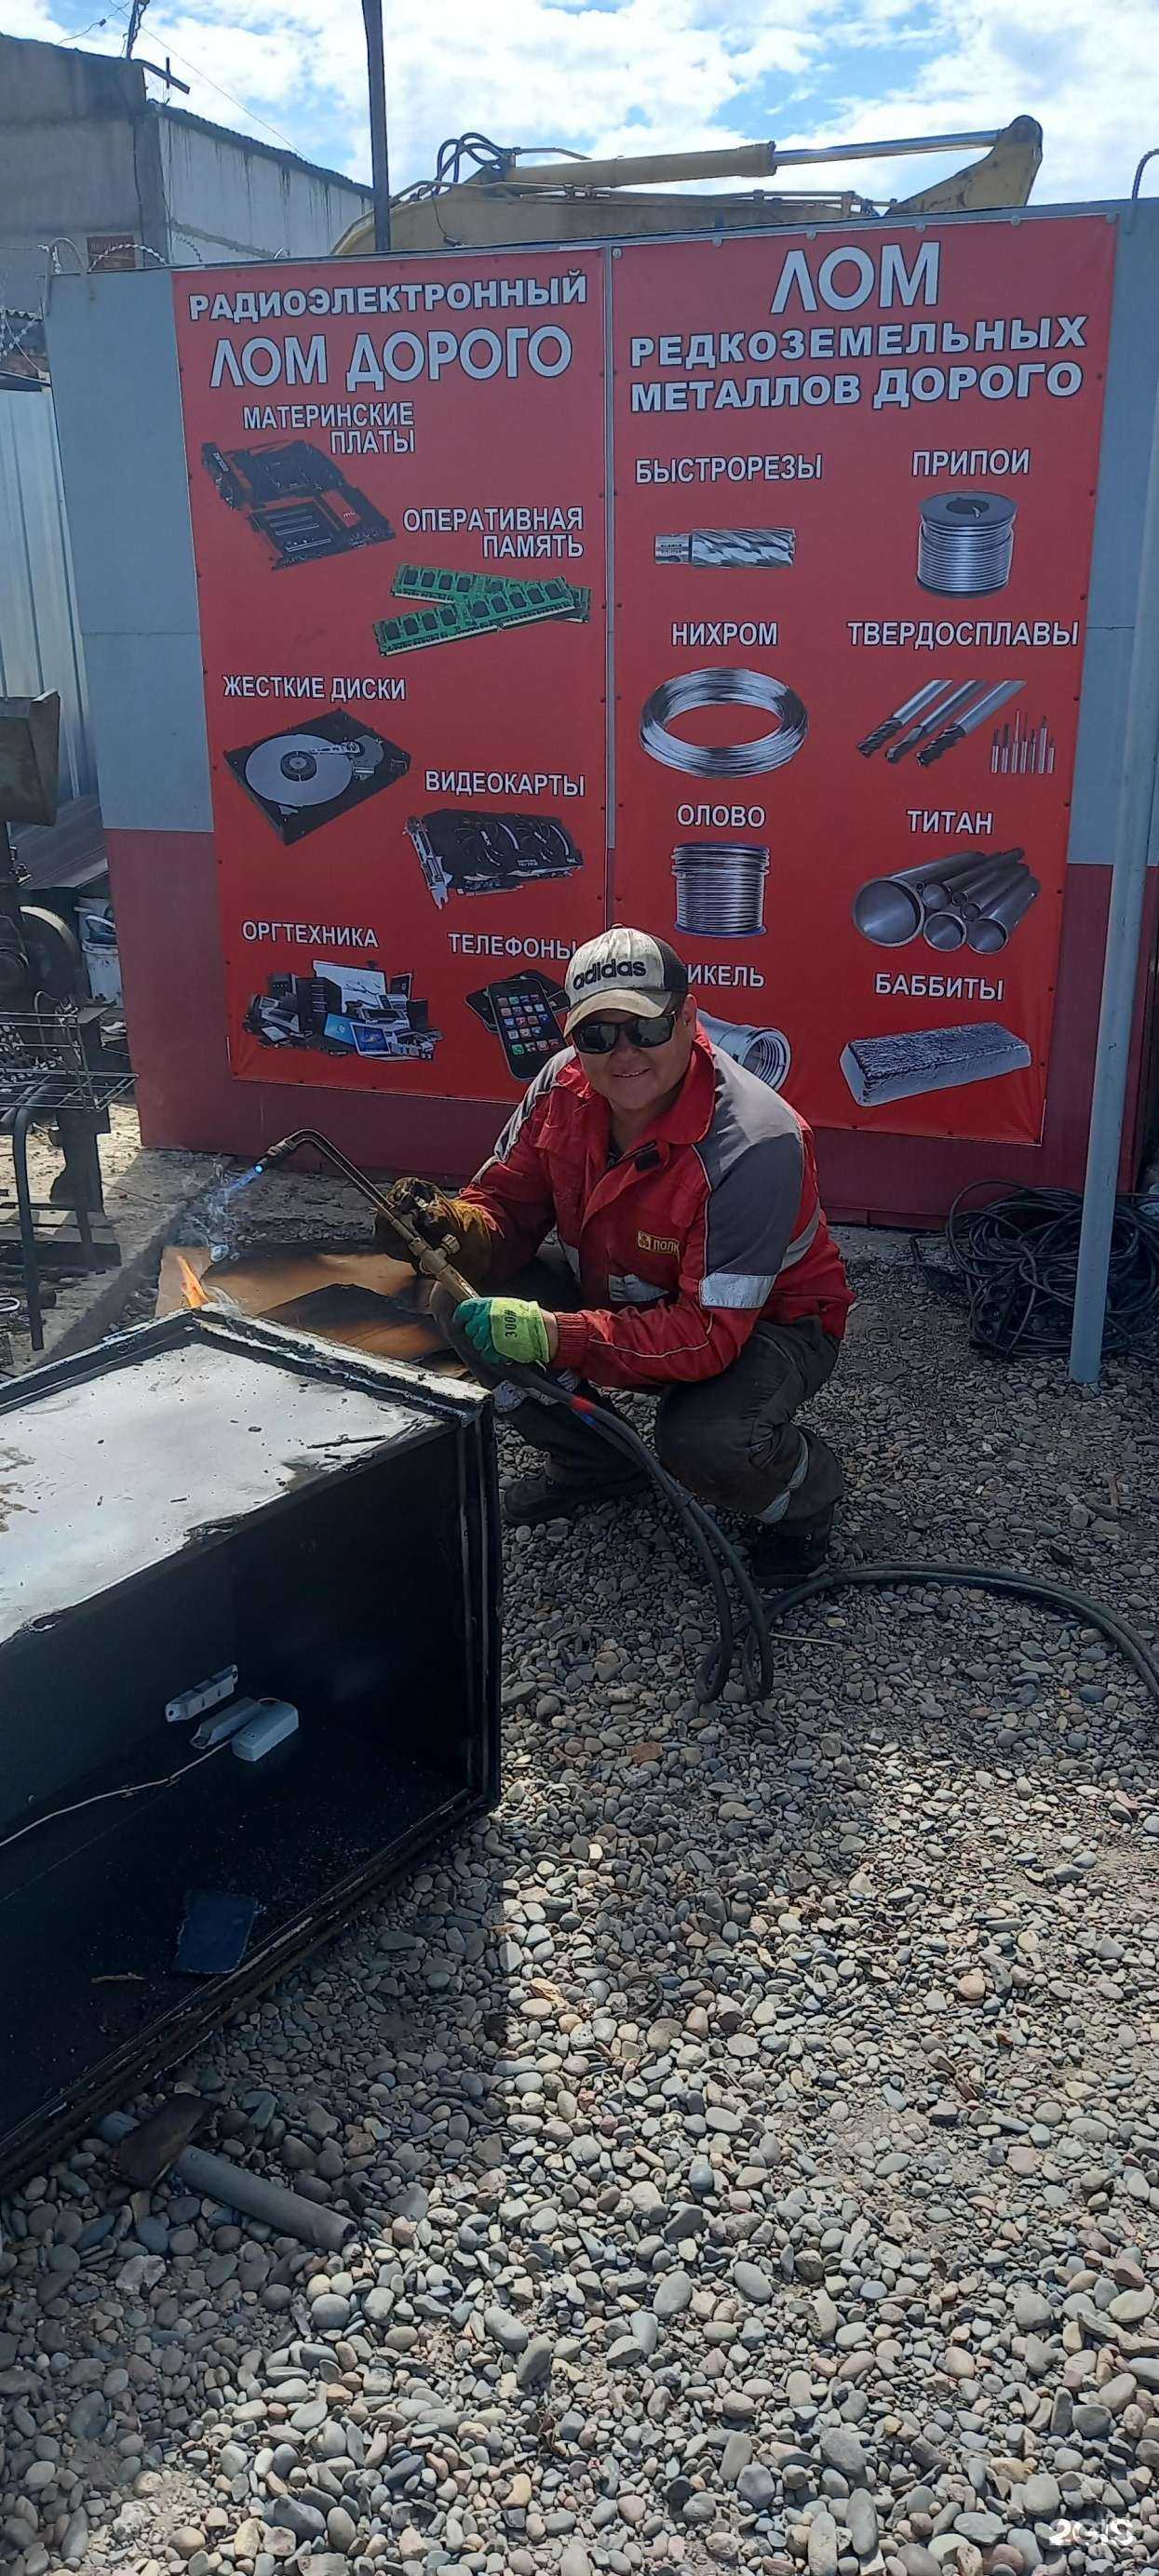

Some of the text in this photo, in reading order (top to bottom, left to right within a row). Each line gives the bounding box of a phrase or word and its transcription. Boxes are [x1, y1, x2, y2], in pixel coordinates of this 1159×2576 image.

[770, 242, 940, 315] ЛОМ
[189, 269, 587, 323] РАДИОЭЛЕКТРОННЫЙ
[630, 315, 1087, 369] РЕДКОЗЕМЕЛЬНЫХ
[209, 325, 573, 392] ЛОМ ДОРОГО
[630, 361, 1084, 412] МЕТАЛЛОВ ДОРОГО
[243, 402, 415, 430] МАТЕРИНСКИЕ
[330, 430, 416, 455] ПЛАТЫ
[635, 454, 823, 484] БЫСТРОРЕЗЫ
[912, 449, 1031, 476] ПРИПОИ
[402, 507, 585, 533] ОПЕРАТИВНАЯ
[482, 533, 585, 558] ПАМЯТЬ
[671, 622, 778, 646] НИХРОМ
[847, 621, 1080, 651] ТВЕРДОСПЛАВЫ
[222, 675, 407, 703] ЖЕСТКИЕ ДИСКИ
[425, 771, 586, 797] ВИДЕОКАРТЫ
[677, 804, 766, 827] ОЛОВО
[907, 809, 993, 836] ТИТАН
[241, 921, 380, 948] ОРГТЕХНИКА
[448, 932, 577, 960] ТЕЛЕФОНЫ
[573, 959, 647, 990] adidas
[686, 963, 766, 988] ИКЕЛЬ
[875, 973, 1004, 1002] БАББИТЫ
